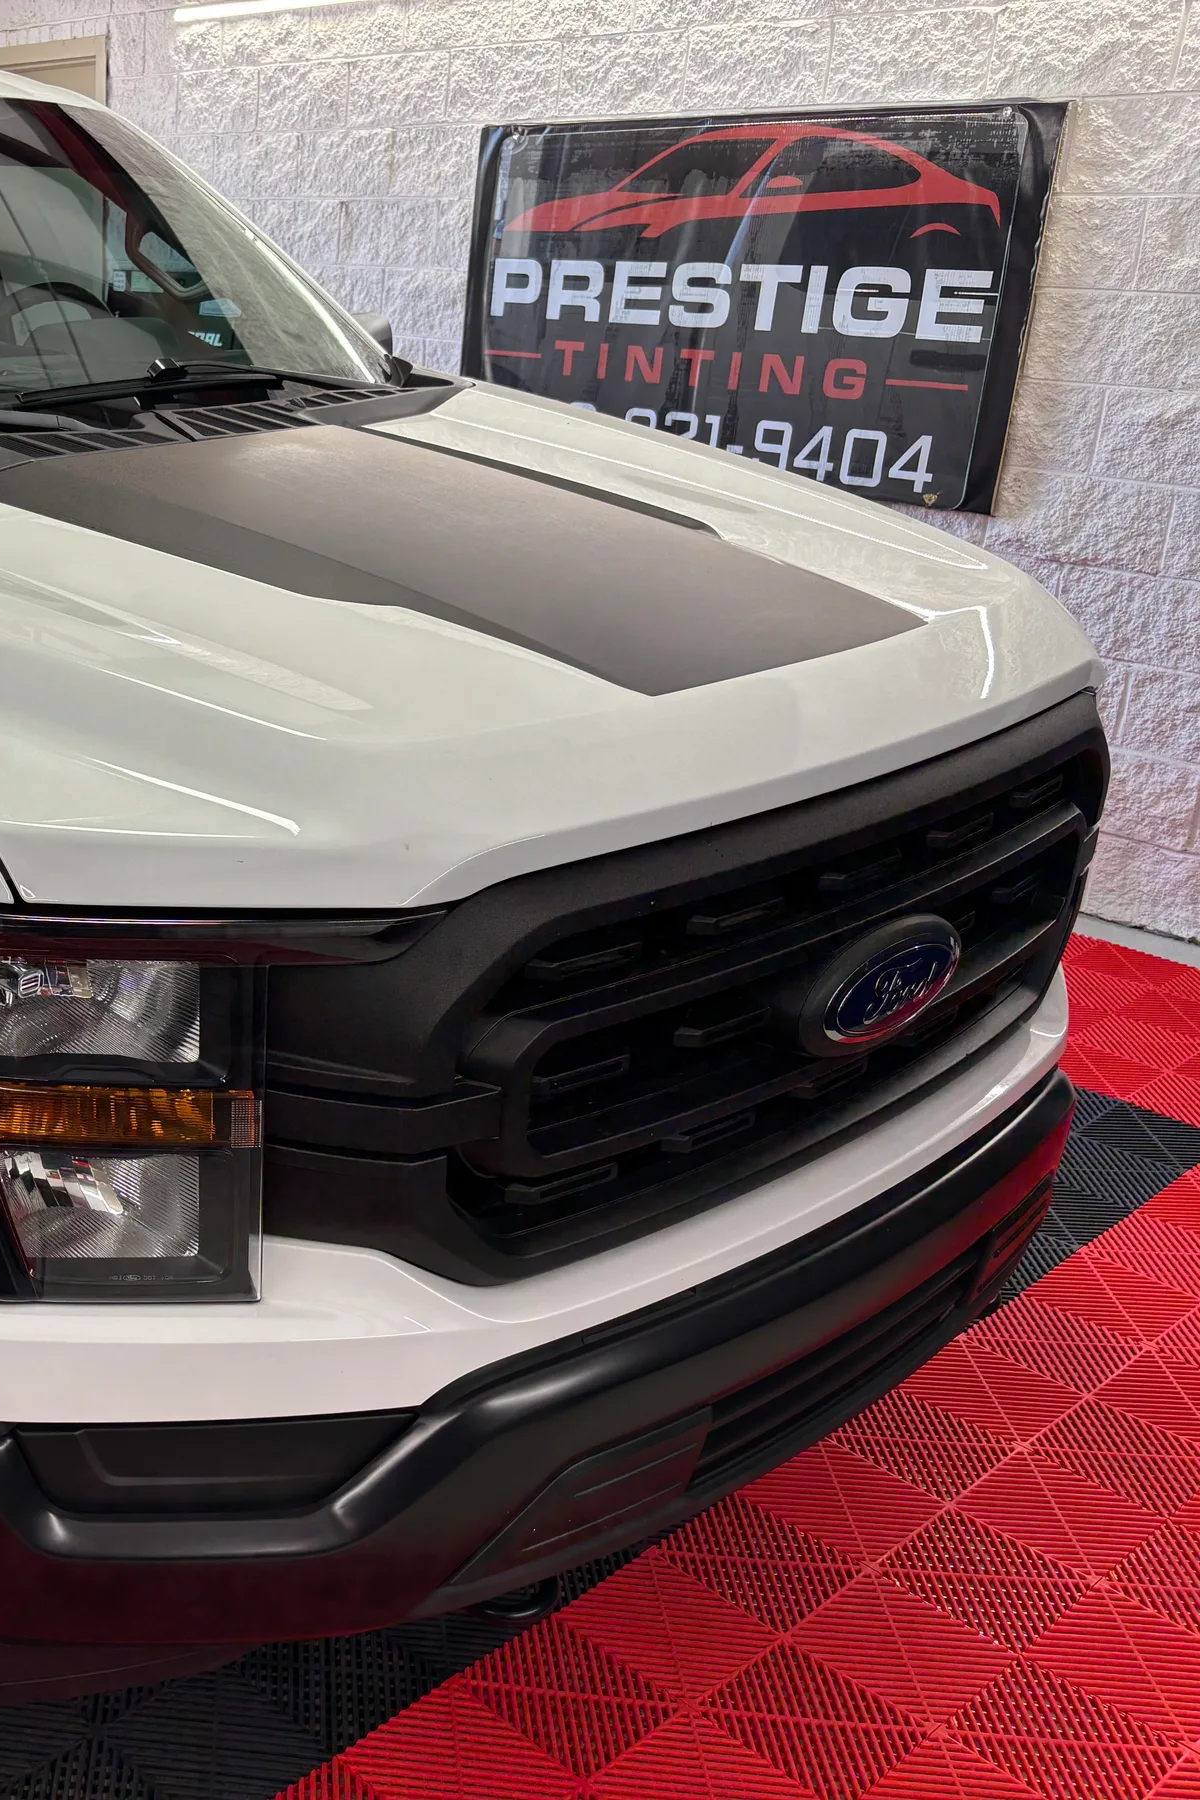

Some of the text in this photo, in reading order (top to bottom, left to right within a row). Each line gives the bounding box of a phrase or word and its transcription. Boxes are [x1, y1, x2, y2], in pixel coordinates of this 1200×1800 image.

[490, 257, 995, 343] PRESTIGE
[554, 340, 867, 400] TINTING
[863, 957, 939, 1025] Ford
